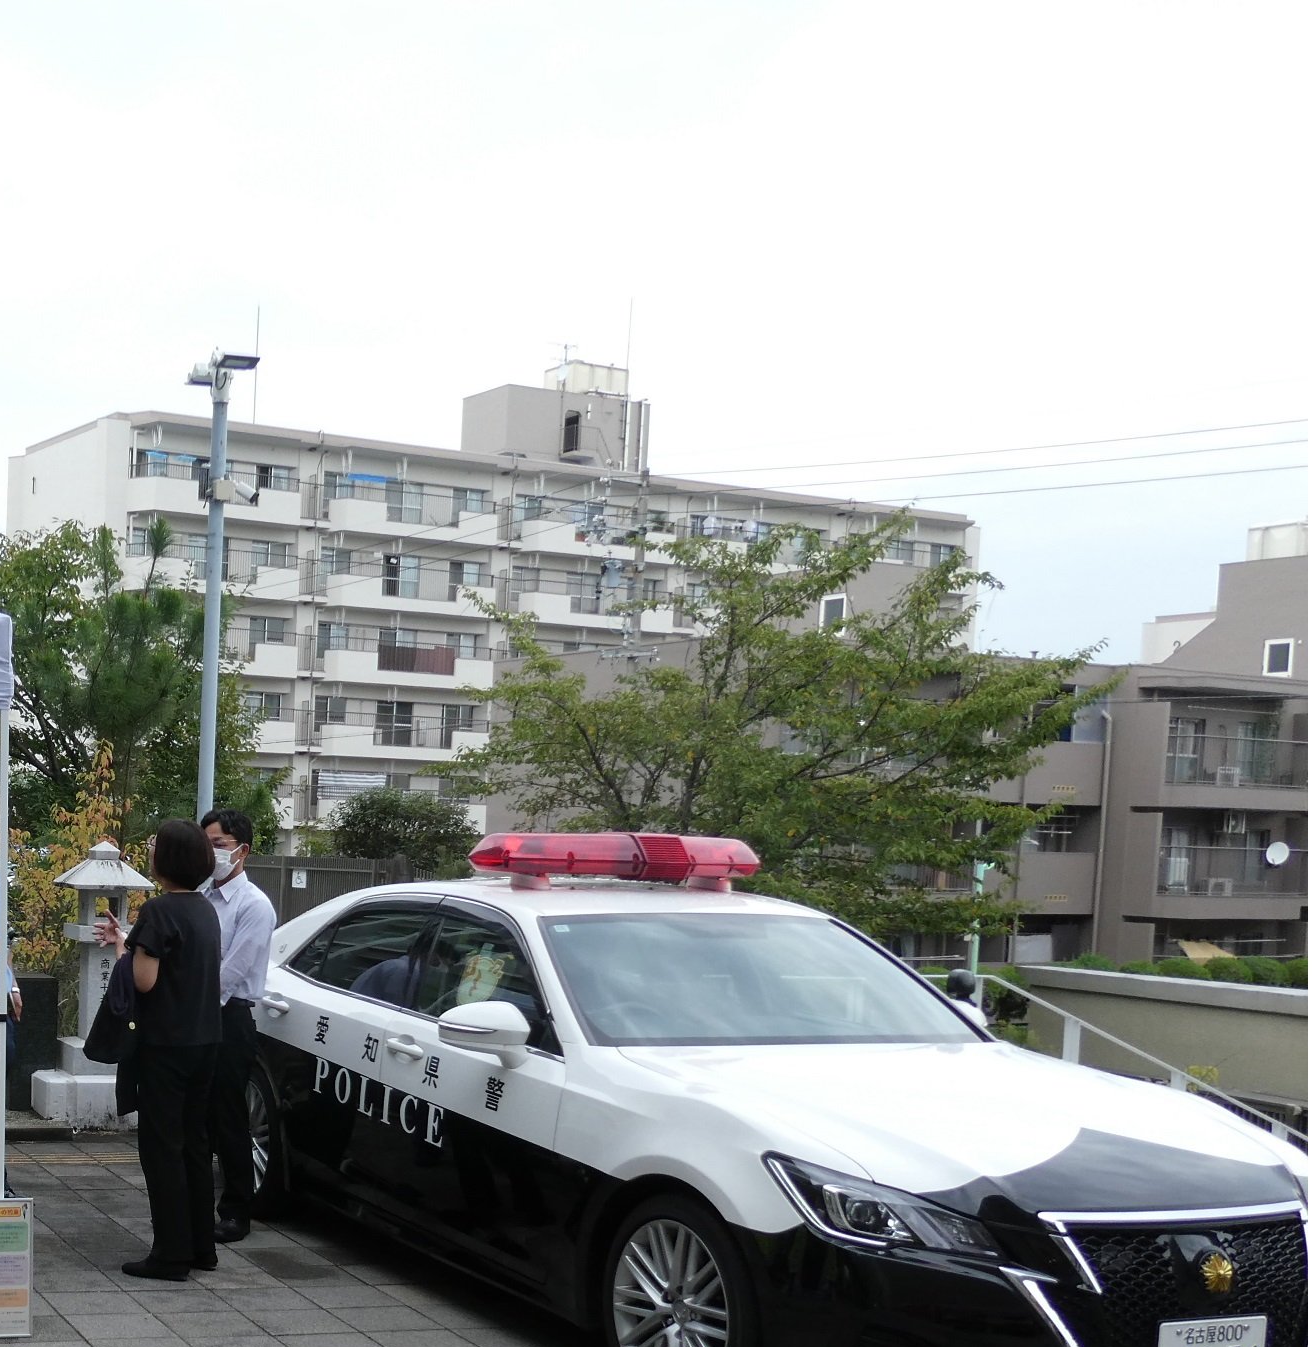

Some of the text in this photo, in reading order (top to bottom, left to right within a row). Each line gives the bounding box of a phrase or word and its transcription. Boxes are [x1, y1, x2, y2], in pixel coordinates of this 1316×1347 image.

[313, 1056, 444, 1148] POLICE
[314, 1016, 504, 1112] 愛知県警
